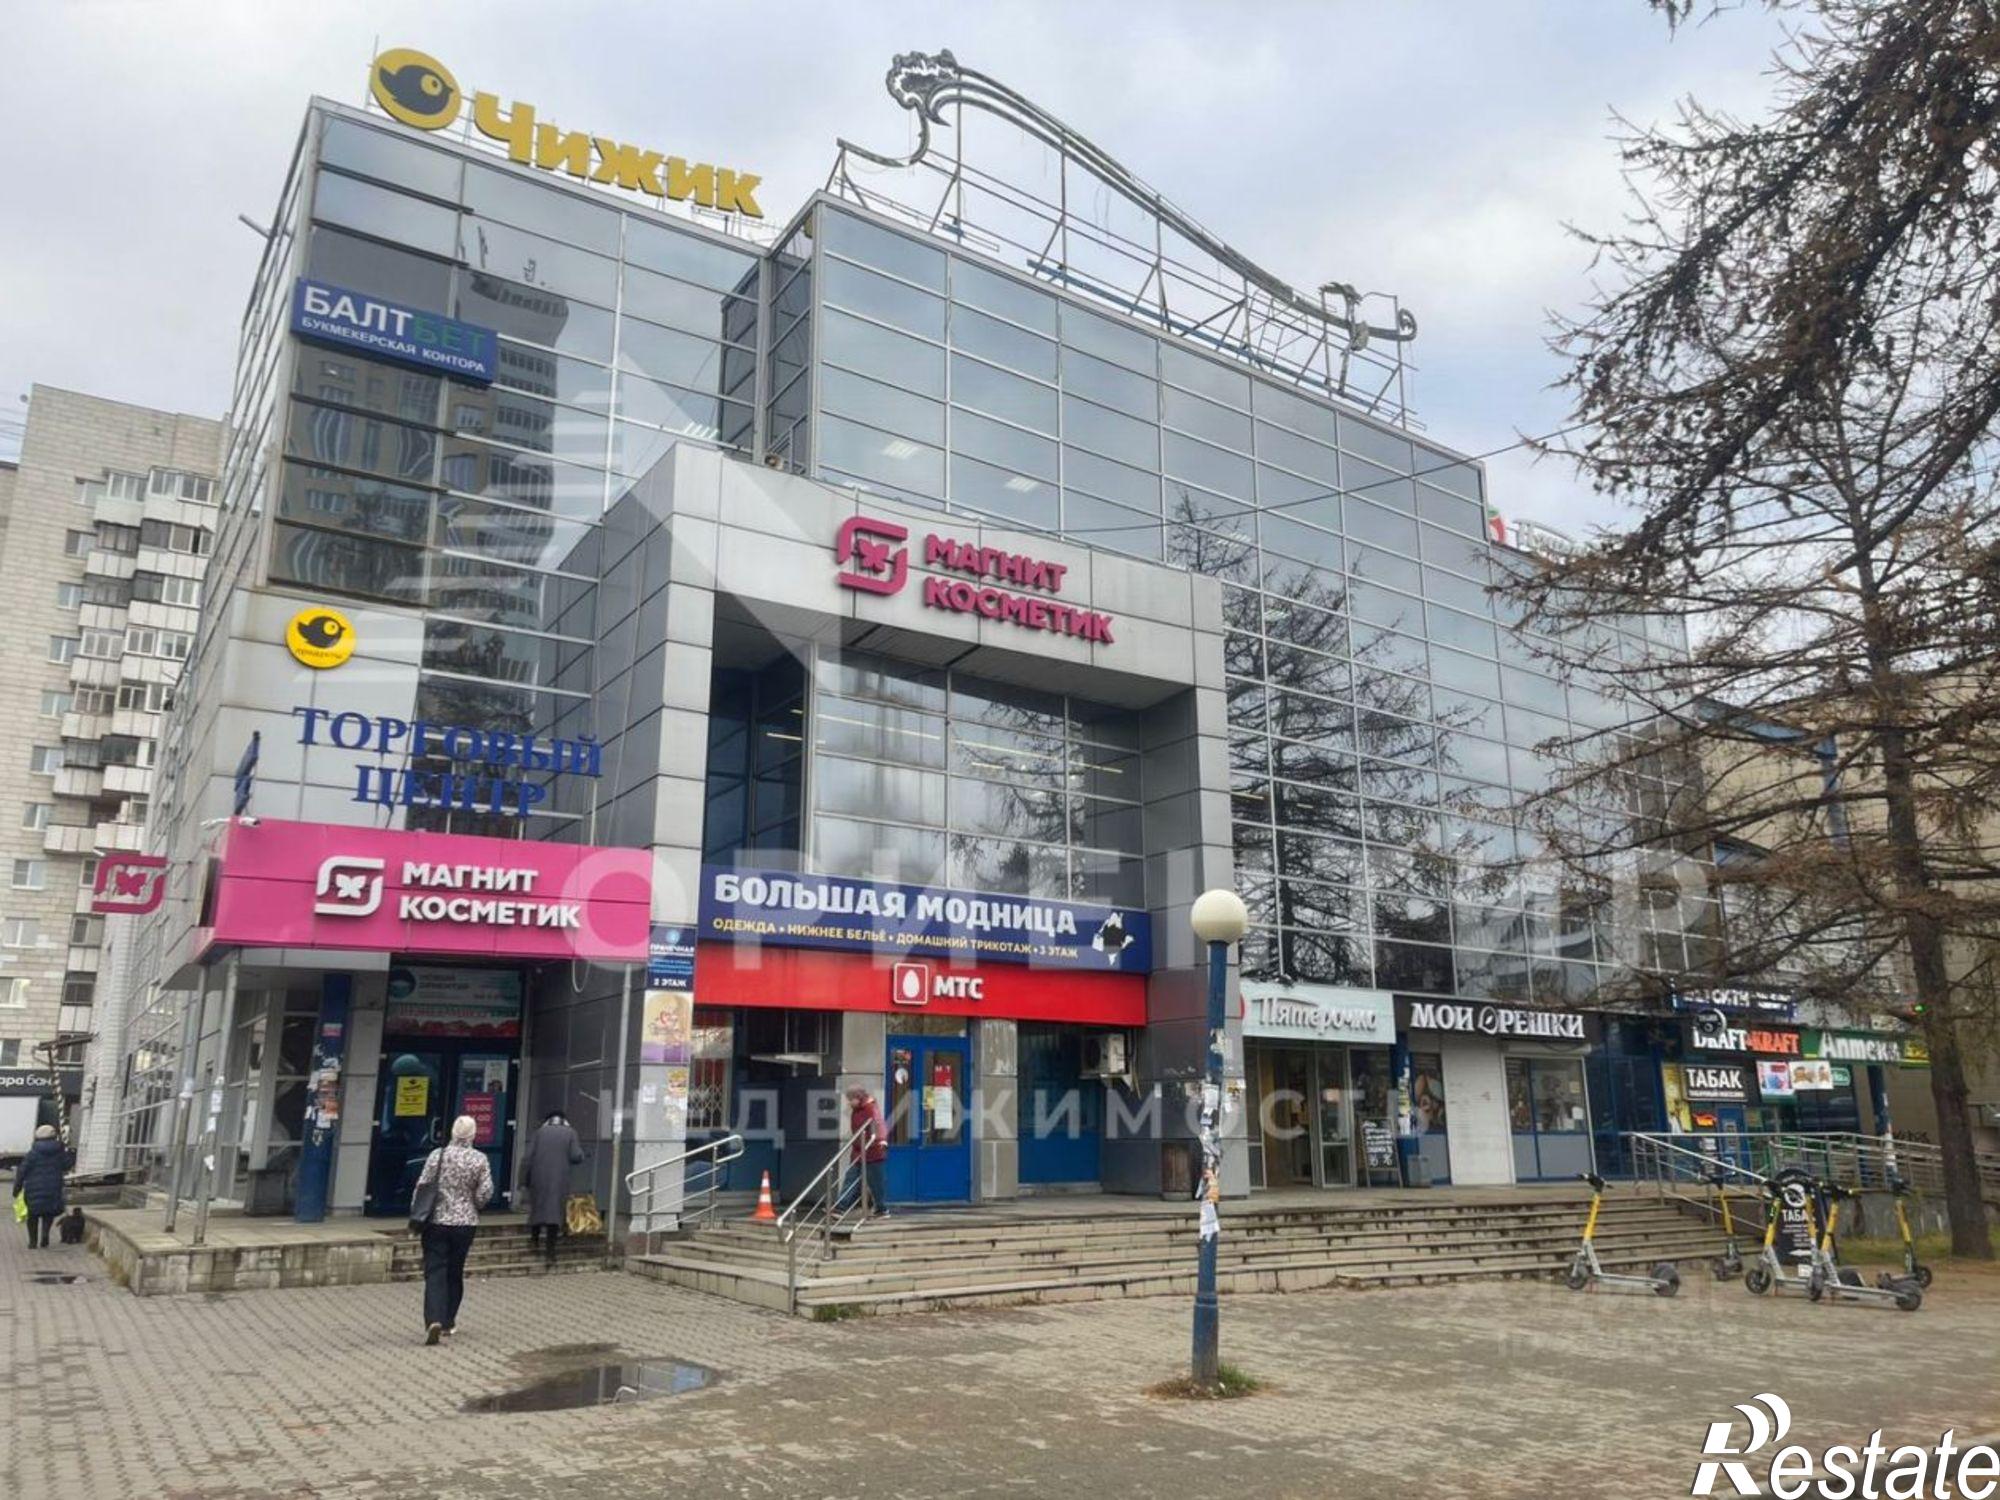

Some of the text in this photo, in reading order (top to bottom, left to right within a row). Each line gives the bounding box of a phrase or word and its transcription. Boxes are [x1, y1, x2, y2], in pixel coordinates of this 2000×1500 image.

[303, 285, 488, 356] БАЛТБЕТ
[302, 316, 486, 374] БУКМЕКЕРСКАЯ КОНТОРА
[924, 533, 1068, 593] МАГНИТ
[923, 576, 1115, 645] КОСМЕТИК
[292, 705, 604, 778] ТОРГОВЫЙ
[351, 764, 547, 818] ЦЕНТР
[402, 861, 539, 893] МАГНИТ
[399, 895, 582, 929] КОСМЕТИК
[715, 873, 1078, 938] БОЛЬШАЯ МОДНИЦА
[713, 917, 1079, 960] ОДЕЖДА НИЖНЕЕ БЕЛЬЁ ДОМАШНИЙ ТРИКОТАЖ 3 ЭТАЖ
[933, 975, 985, 1000] МТС
[1410, 1002, 1586, 1039] МОИ ОРЕШКИ
[1686, 1068, 1743, 1089] ТАБАК
[1782, 1209, 1810, 1223] ТАБА
